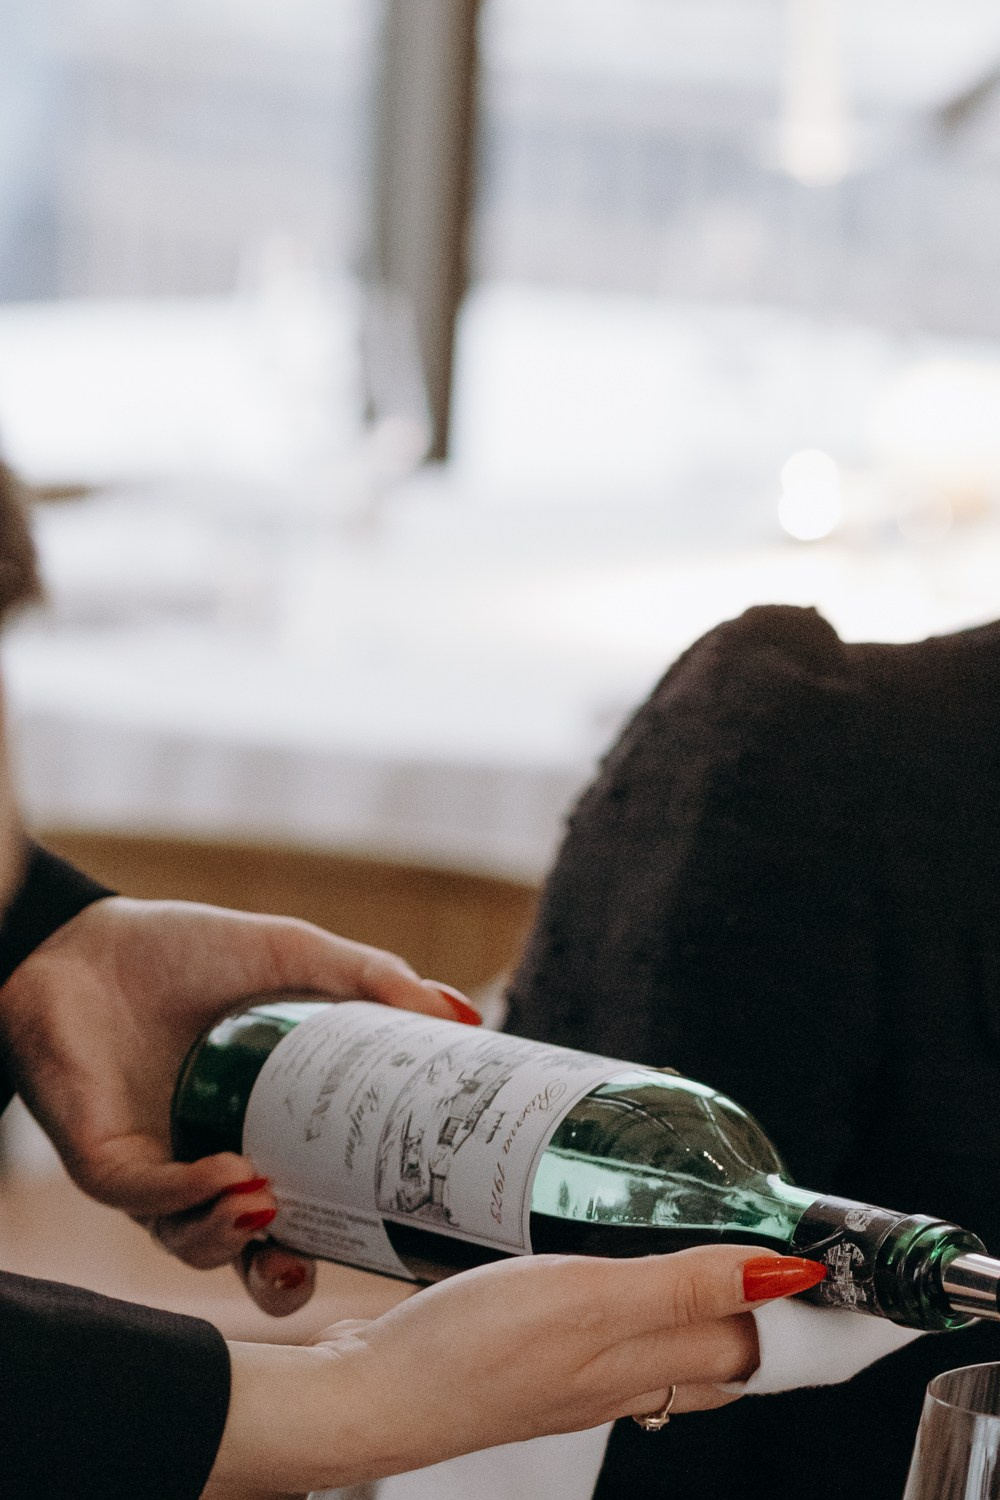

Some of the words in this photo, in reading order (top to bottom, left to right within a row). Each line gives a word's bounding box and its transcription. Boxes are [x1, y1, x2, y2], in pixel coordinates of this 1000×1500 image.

[344, 1080, 386, 1170] Rufina
[503, 1079, 567, 1155] Riserva
[490, 1161, 506, 1225] 1973
